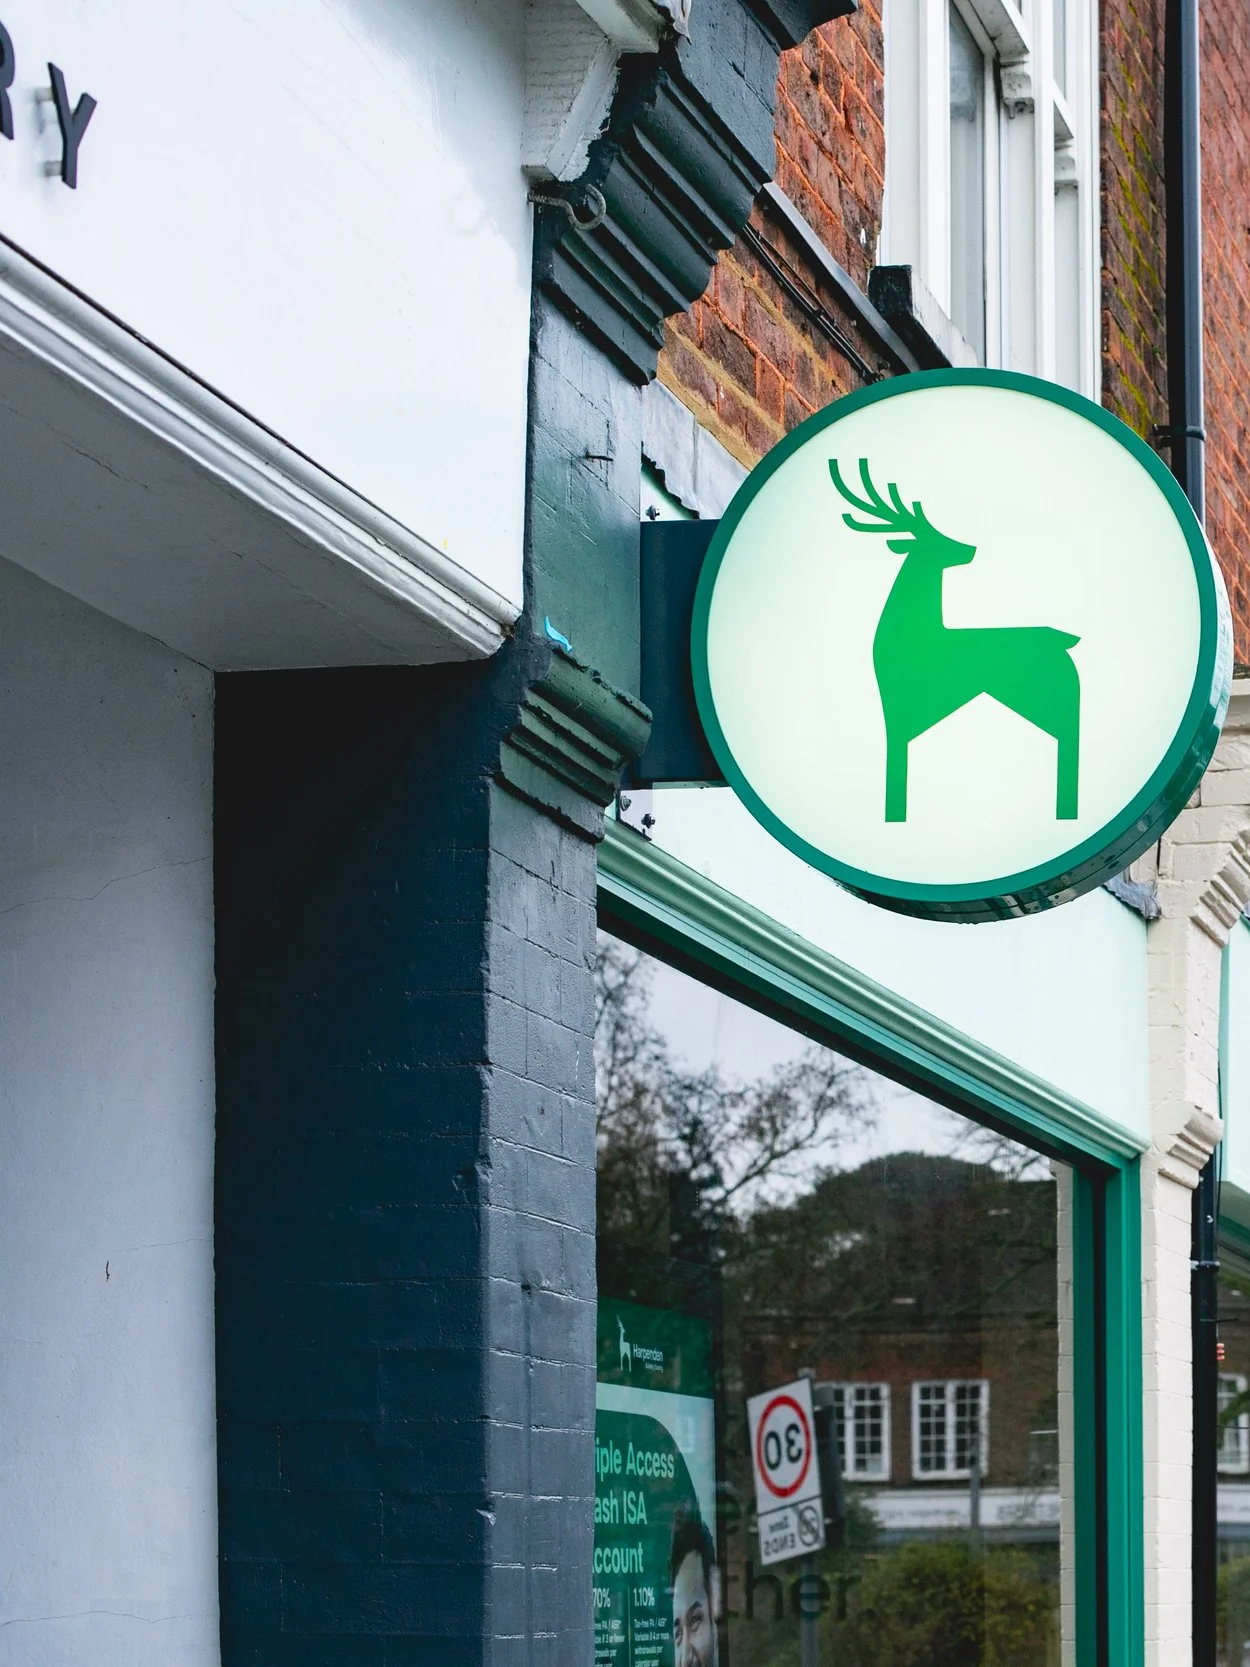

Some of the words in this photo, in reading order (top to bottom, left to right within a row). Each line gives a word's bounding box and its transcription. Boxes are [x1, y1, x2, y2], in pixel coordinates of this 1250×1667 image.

[633, 1343, 663, 1362] Harpenden
[595, 1437, 622, 1482] iple
[626, 1442, 674, 1478] Access
[595, 1490, 619, 1524] ash
[623, 1491, 648, 1525] ISA
[592, 1542, 644, 1574] ccount
[633, 1587, 655, 1607] 1.10%
